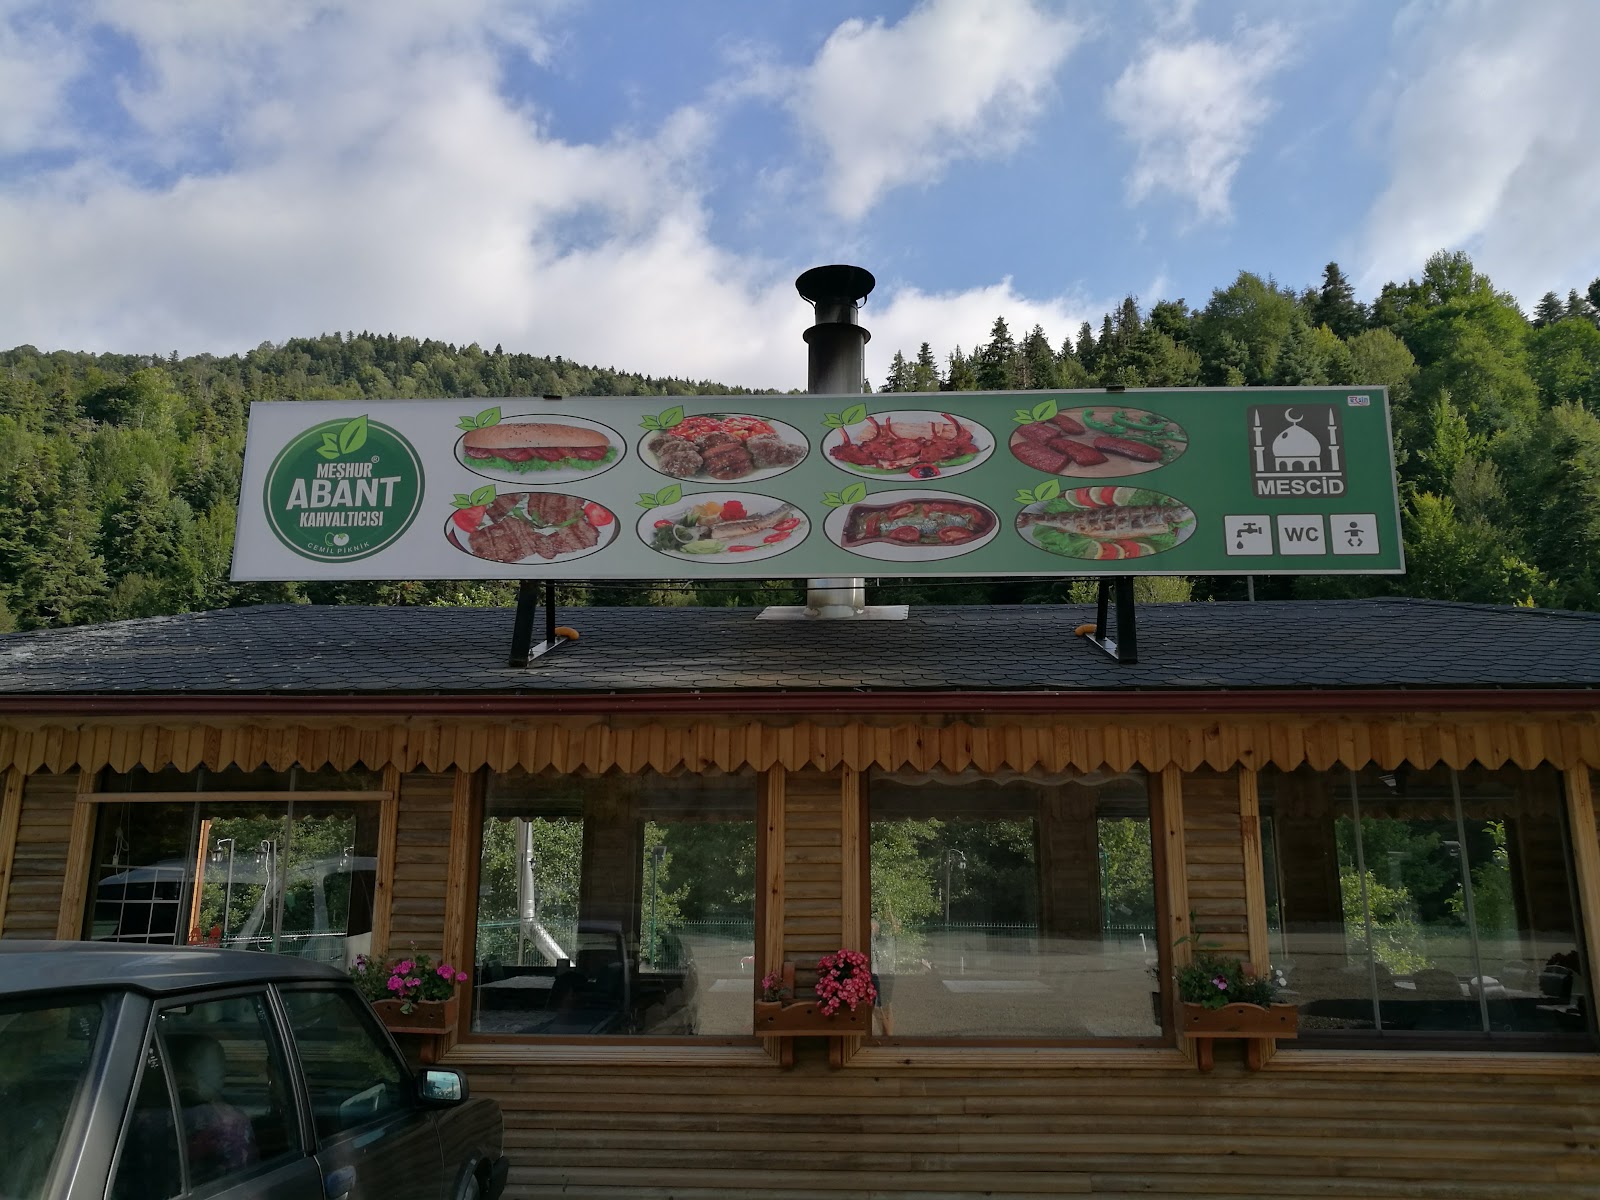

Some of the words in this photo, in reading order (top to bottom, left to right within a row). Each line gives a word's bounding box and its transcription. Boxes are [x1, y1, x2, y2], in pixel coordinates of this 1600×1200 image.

[286, 476, 401, 510] ABANT
[1257, 477, 1344, 495] MESCİD
[300, 511, 383, 527] KAHVALTICISI
[1284, 527, 1319, 542] WC
